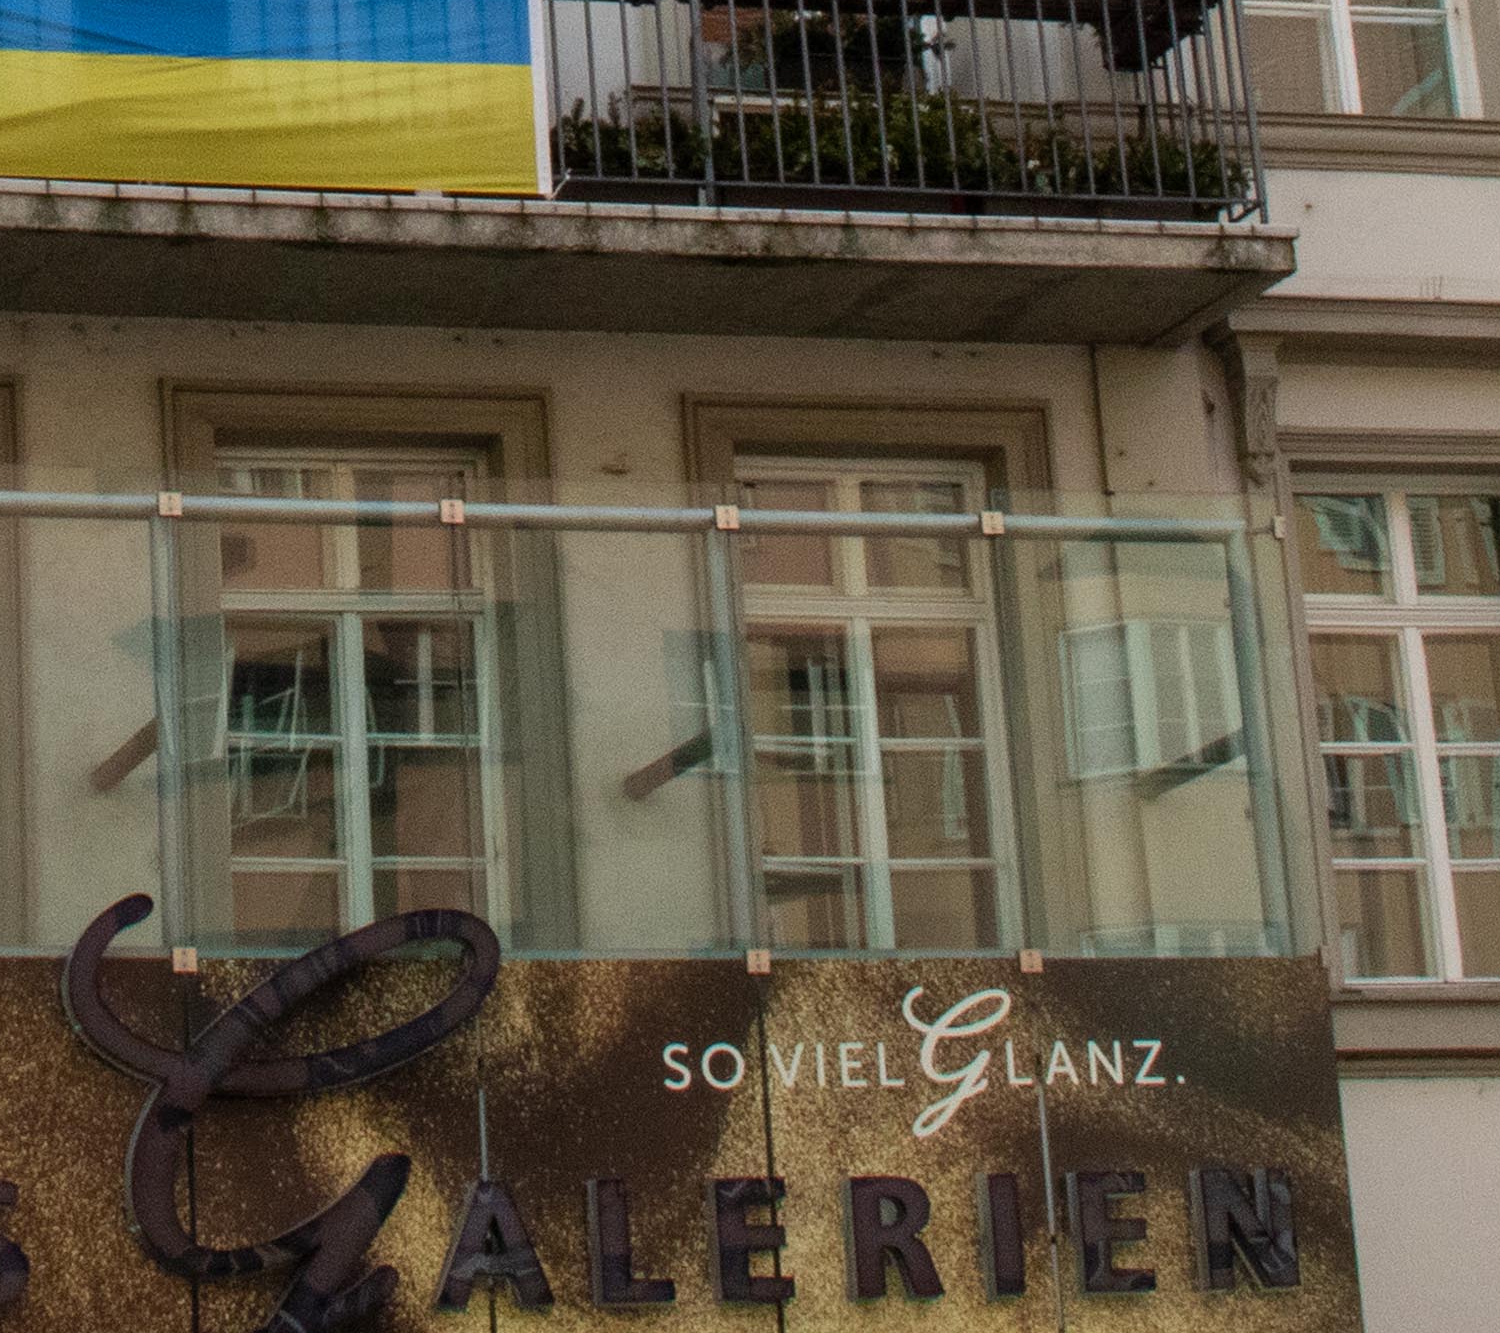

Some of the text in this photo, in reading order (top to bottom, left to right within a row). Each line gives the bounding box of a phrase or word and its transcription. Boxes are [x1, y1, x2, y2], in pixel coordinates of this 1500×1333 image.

[61, 891, 1300, 1333] GALERIEN
[662, 985, 1187, 1137] SO VIEL GLANZ.
